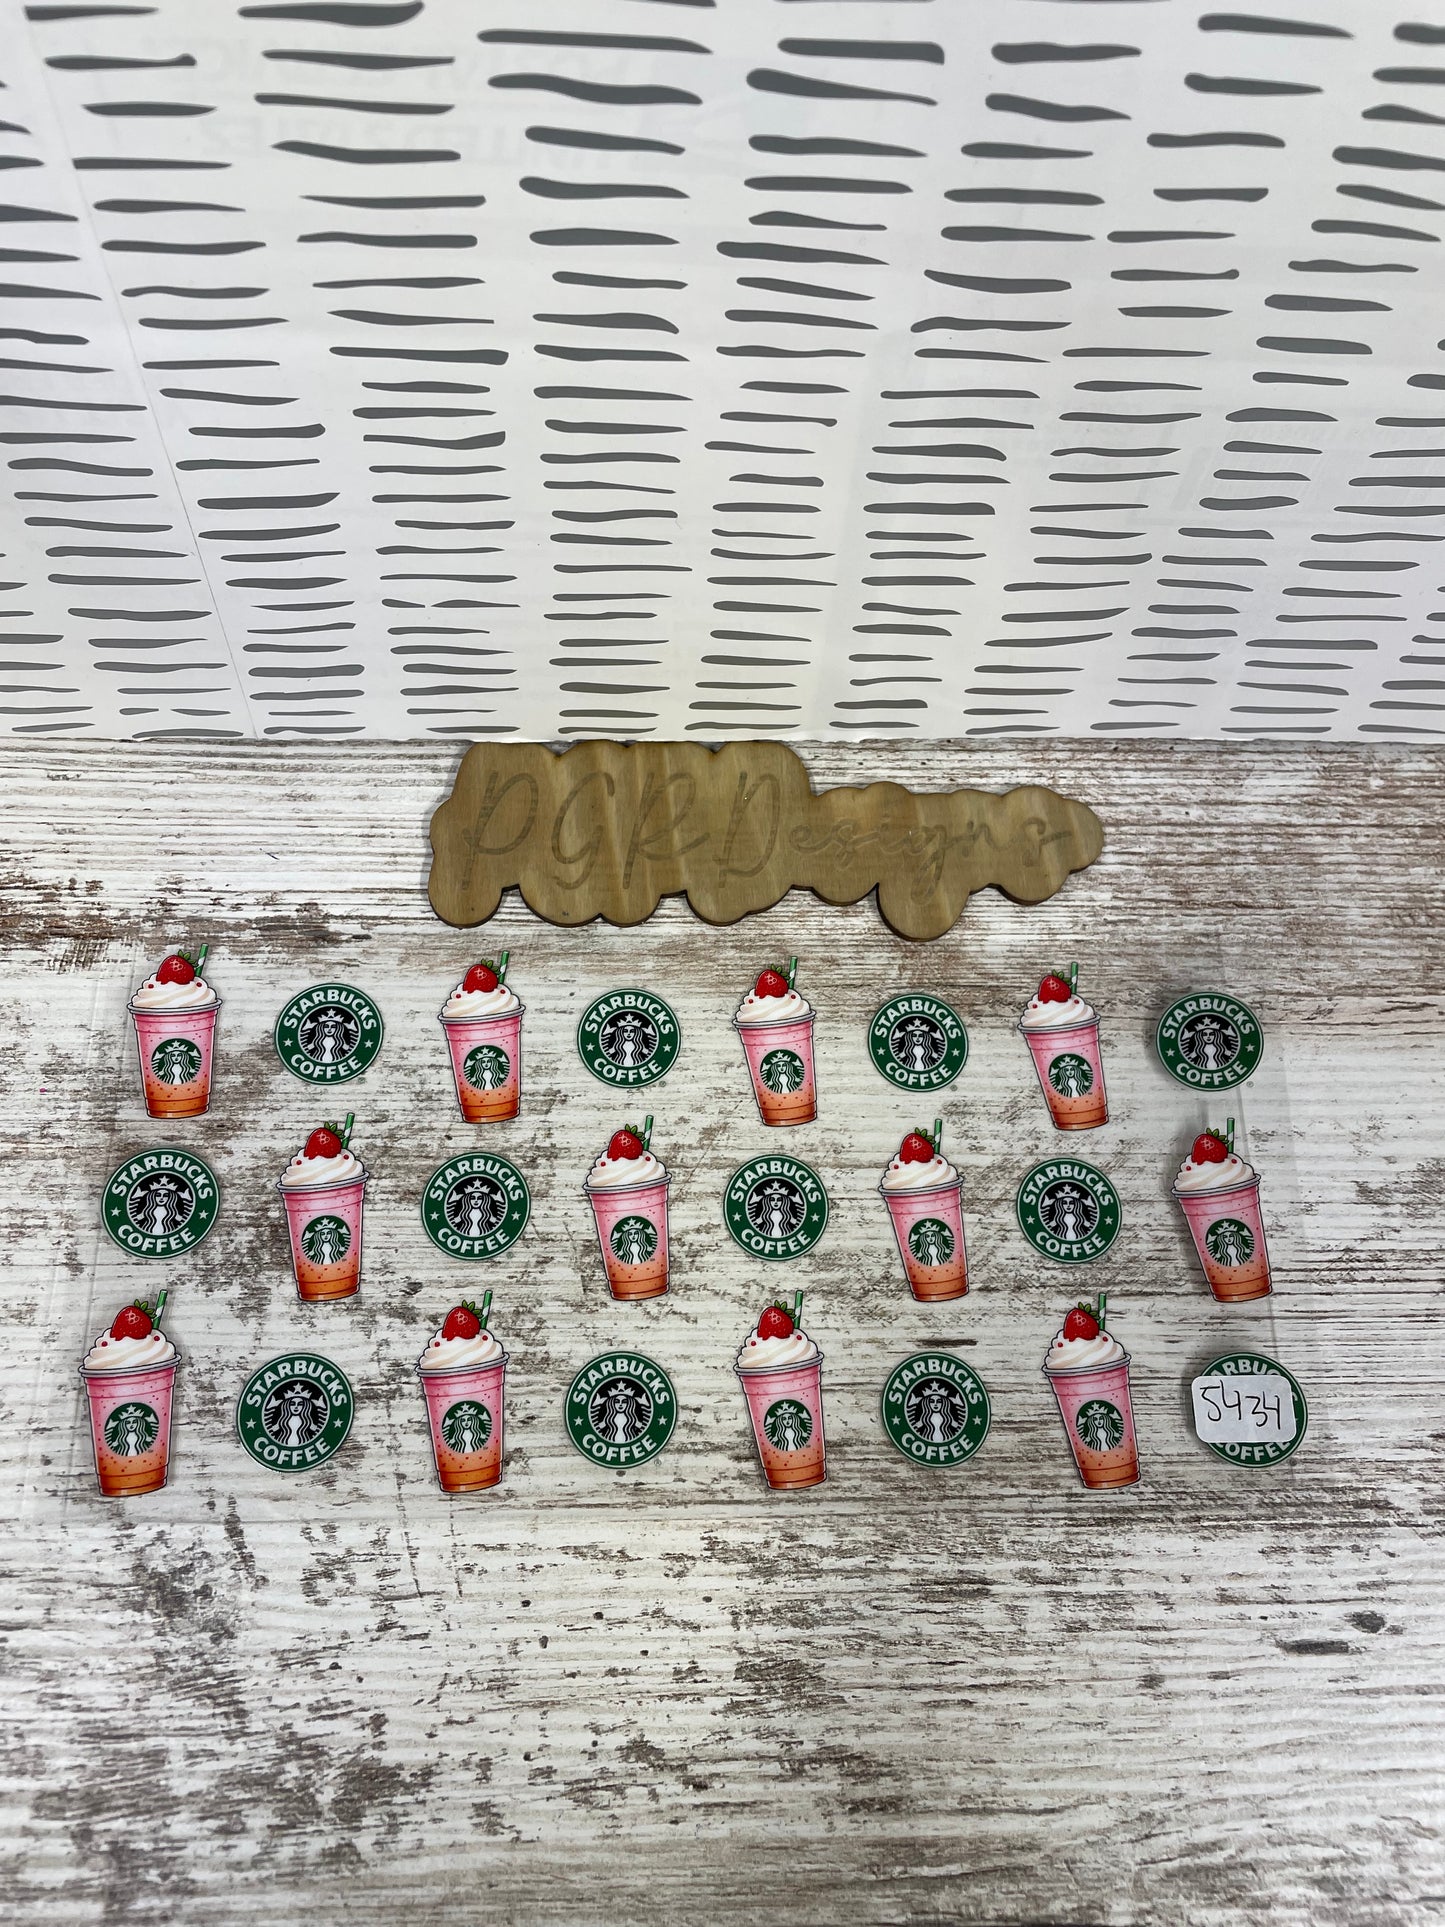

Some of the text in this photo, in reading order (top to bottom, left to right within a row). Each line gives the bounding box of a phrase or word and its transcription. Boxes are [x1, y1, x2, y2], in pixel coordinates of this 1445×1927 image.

[284, 989, 376, 1029] STARBUCKS
[585, 994, 674, 1034] STARBUCKS
[874, 999, 961, 1038] STARBUCKS
[1163, 997, 1254, 1038] STARBUCKS
[291, 1053, 362, 1078] COFFEE
[594, 1058, 662, 1082] COFFEE
[885, 1062, 953, 1086] COFFEE
[1176, 1060, 1248, 1085] COFFEE
[112, 1154, 213, 1199] STARBUCKS
[430, 1158, 524, 1201] STARBUCKS
[731, 1160, 822, 1203] STARBUCKS
[1023, 1164, 1113, 1206] STARBUCKS
[118, 1224, 195, 1252] COFFEE
[437, 1227, 510, 1254] COFFEE
[742, 1228, 811, 1255] COFFEE
[1036, 1231, 1106, 1257] COFFEE
[246, 1360, 347, 1407] STARBUCKS
[573, 1358, 669, 1405] STARBUCKS
[889, 1359, 982, 1404] STARBUCKS
[1200, 1379, 1281, 1430] 5434
[254, 1436, 331, 1465] COFFEE
[582, 1434, 656, 1462] COFFEE
[901, 1433, 973, 1461] COFFEE
